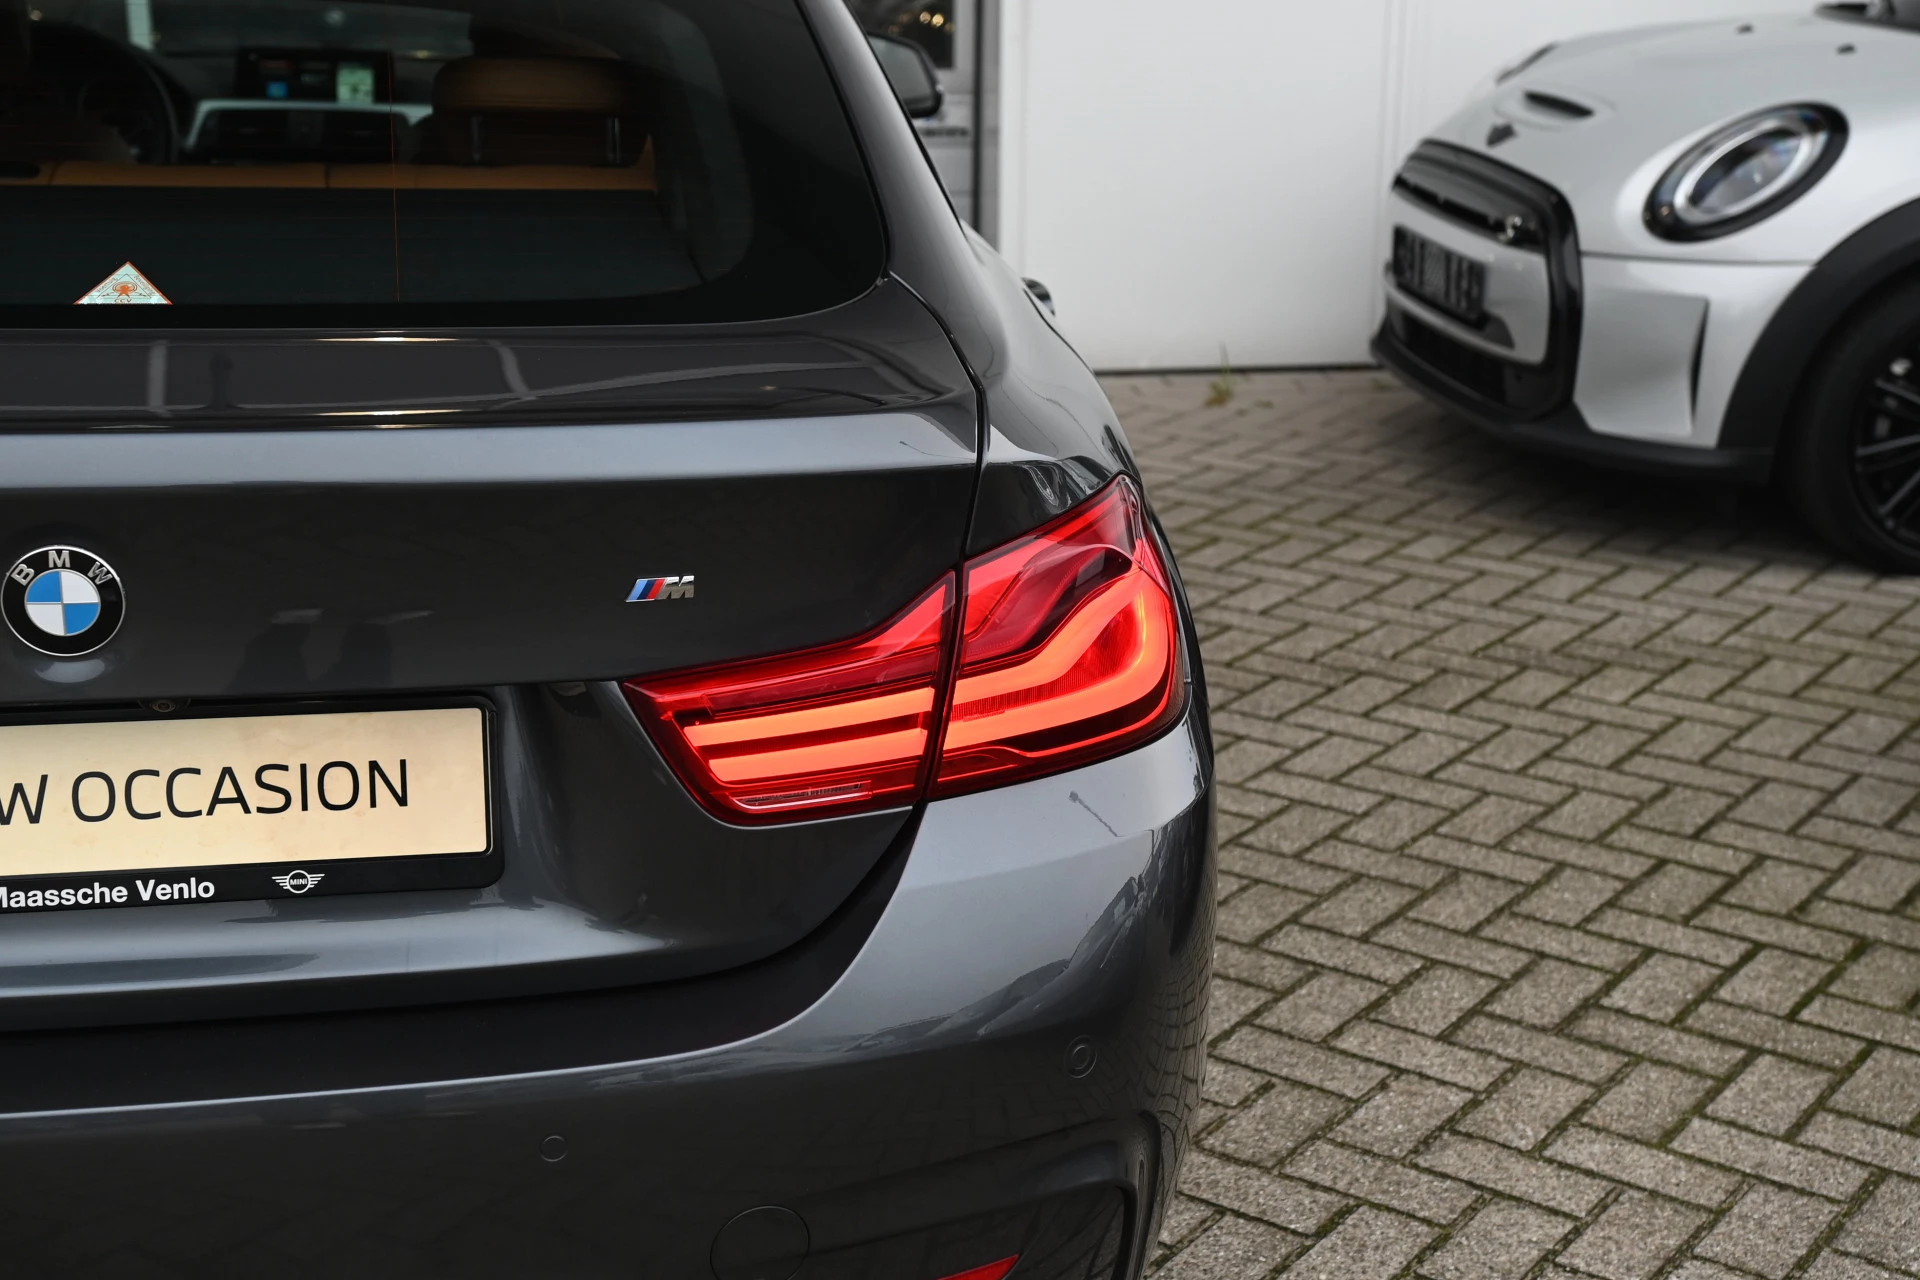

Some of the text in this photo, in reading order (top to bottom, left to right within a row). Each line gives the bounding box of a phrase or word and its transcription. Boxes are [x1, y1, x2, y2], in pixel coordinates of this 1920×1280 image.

[11, 550, 113, 586] BMW
[71, 758, 409, 823] OCCASION
[136, 877, 215, 901] Venlo
[289, 878, 308, 886] MINI
